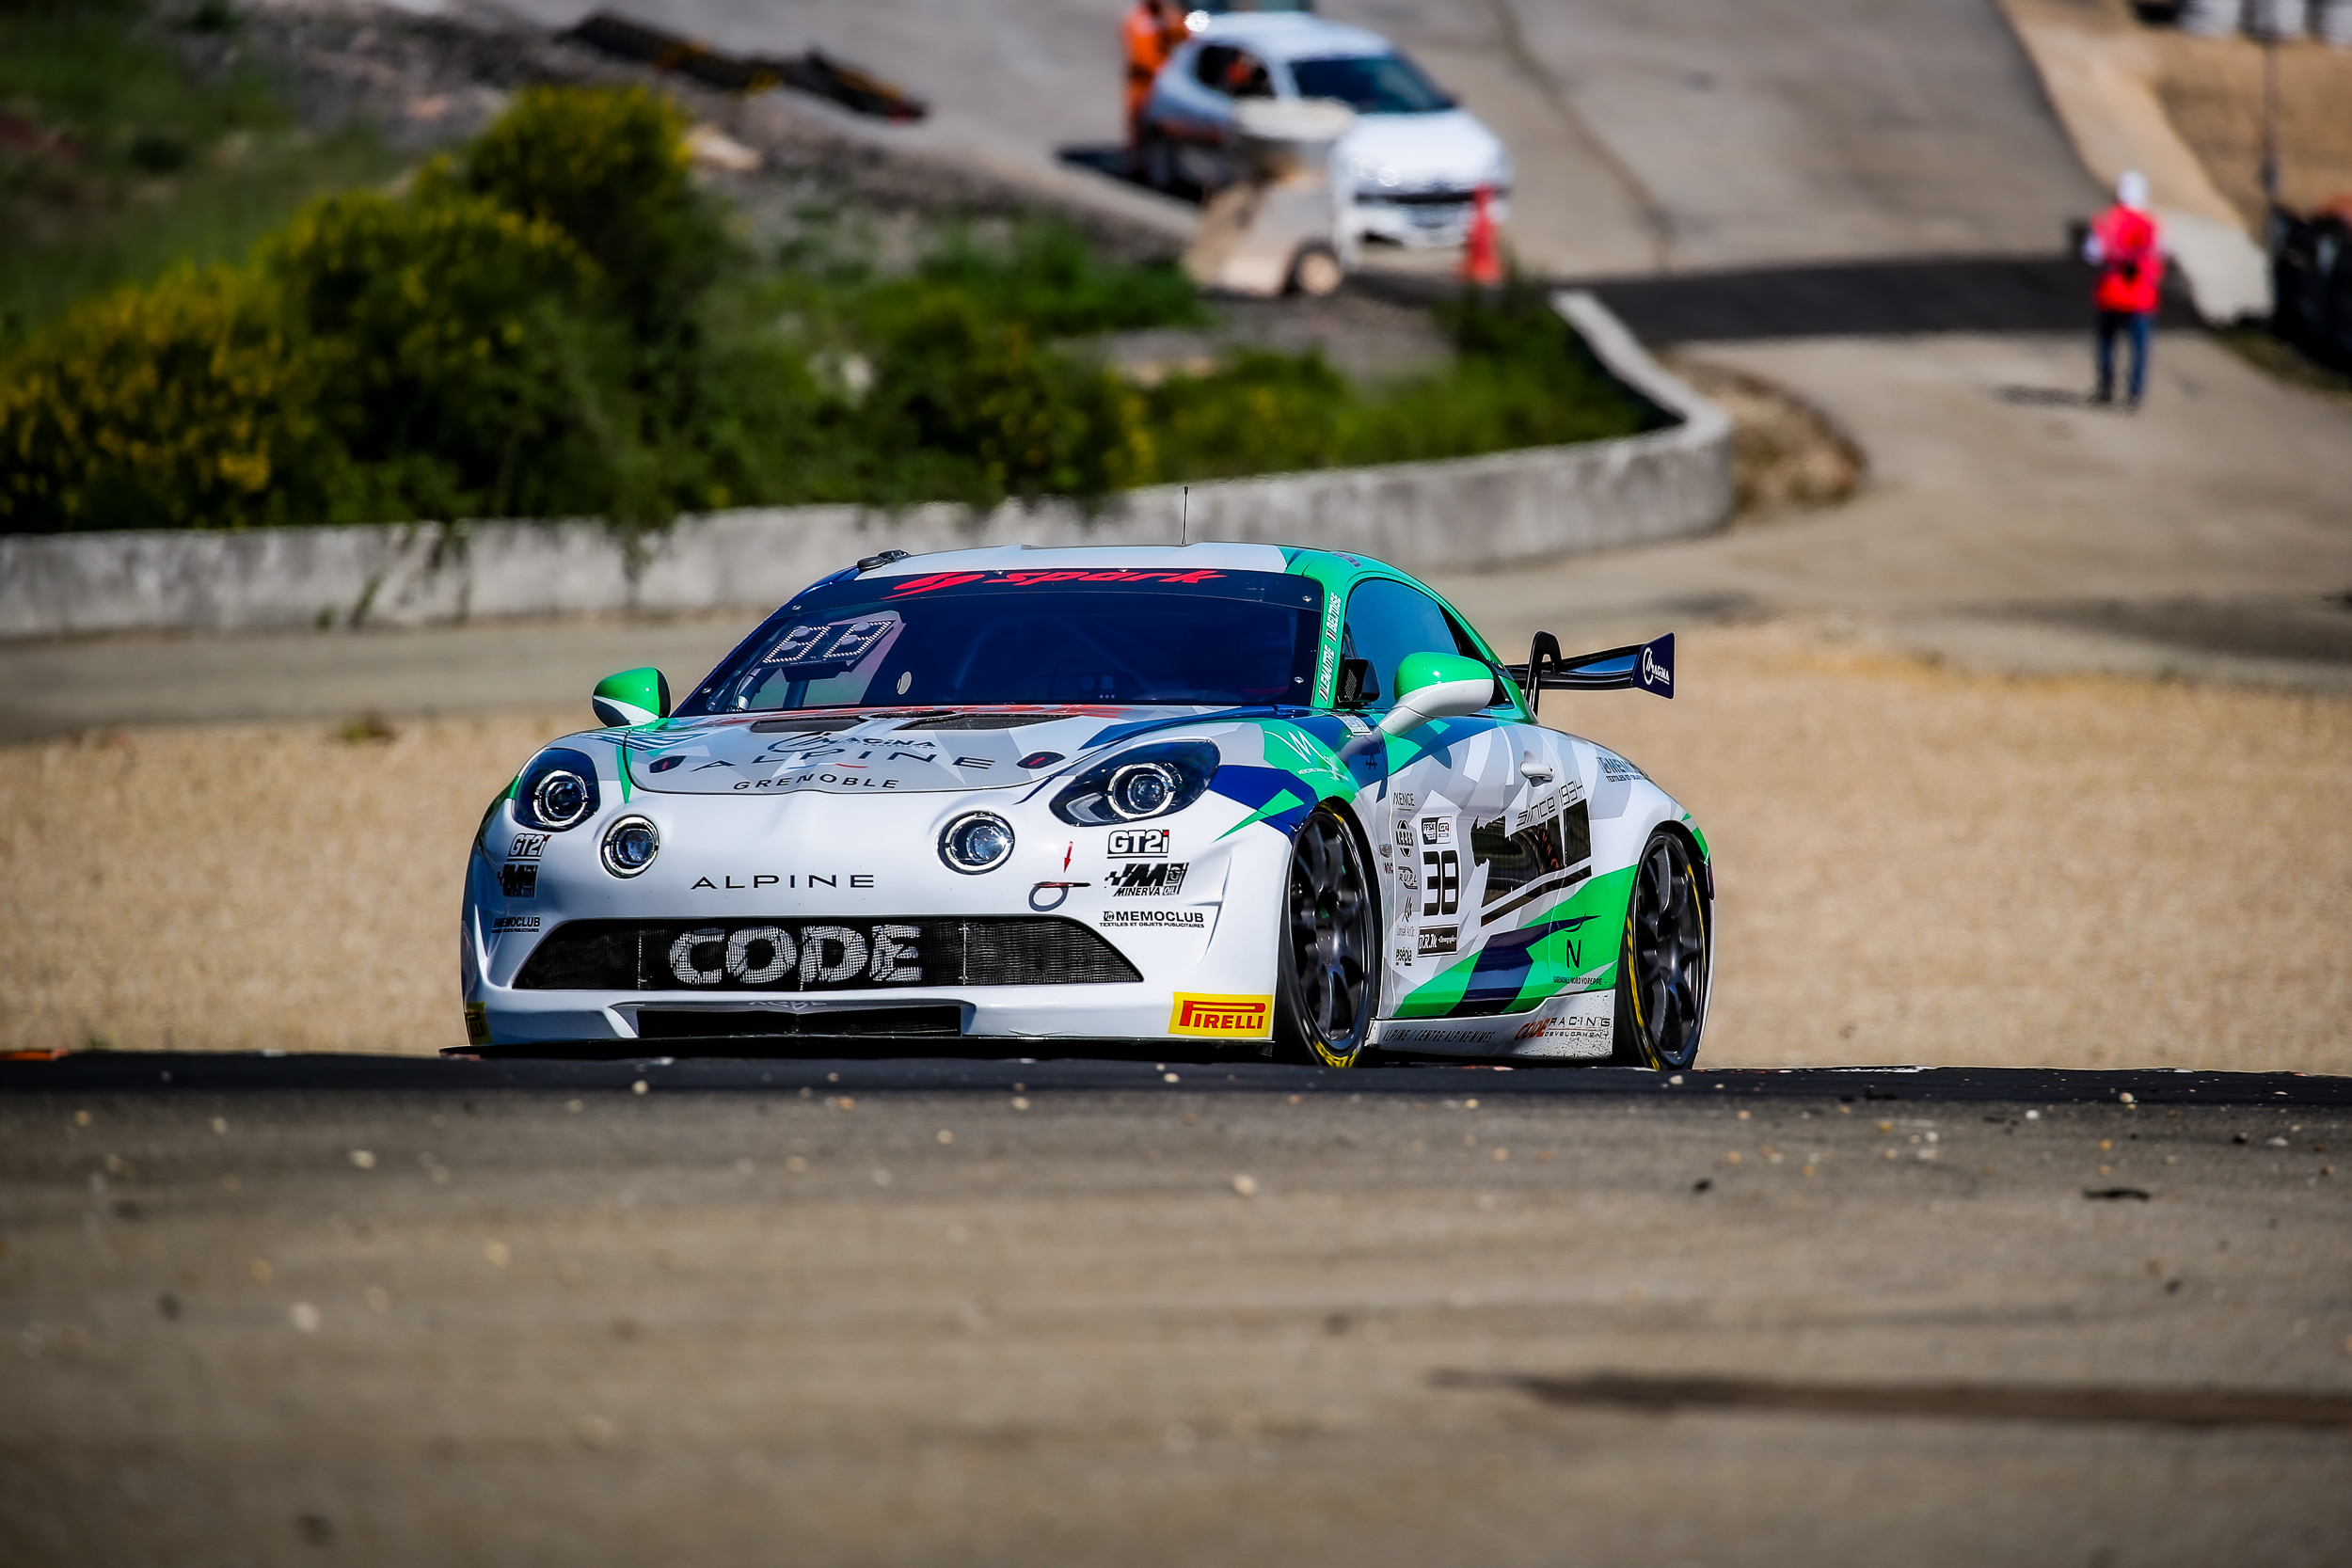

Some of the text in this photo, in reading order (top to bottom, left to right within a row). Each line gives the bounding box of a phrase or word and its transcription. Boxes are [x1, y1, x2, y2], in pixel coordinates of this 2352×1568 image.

[1327, 591, 1342, 633] BELTOISE
[689, 749, 995, 772] ALPINE
[733, 773, 899, 791] GRENOBLE
[1558, 777, 1585, 807] 1934
[508, 832, 551, 857] GT2i
[1107, 830, 1169, 854] GT2i
[691, 875, 875, 890] ALPINE
[1112, 887, 1160, 896] MINERVA
[1423, 850, 1458, 916] 38
[1116, 911, 1204, 923] MEMOCLUB
[669, 925, 922, 984] CODE
[1581, 977, 1603, 986] VOREPPE
[1179, 1000, 1265, 1030] PIRELLI
[1414, 1029, 1446, 1042] CENTRE
[1442, 1030, 1472, 1043] ALPINE
[1515, 1016, 1612, 1041] CODE RACING
